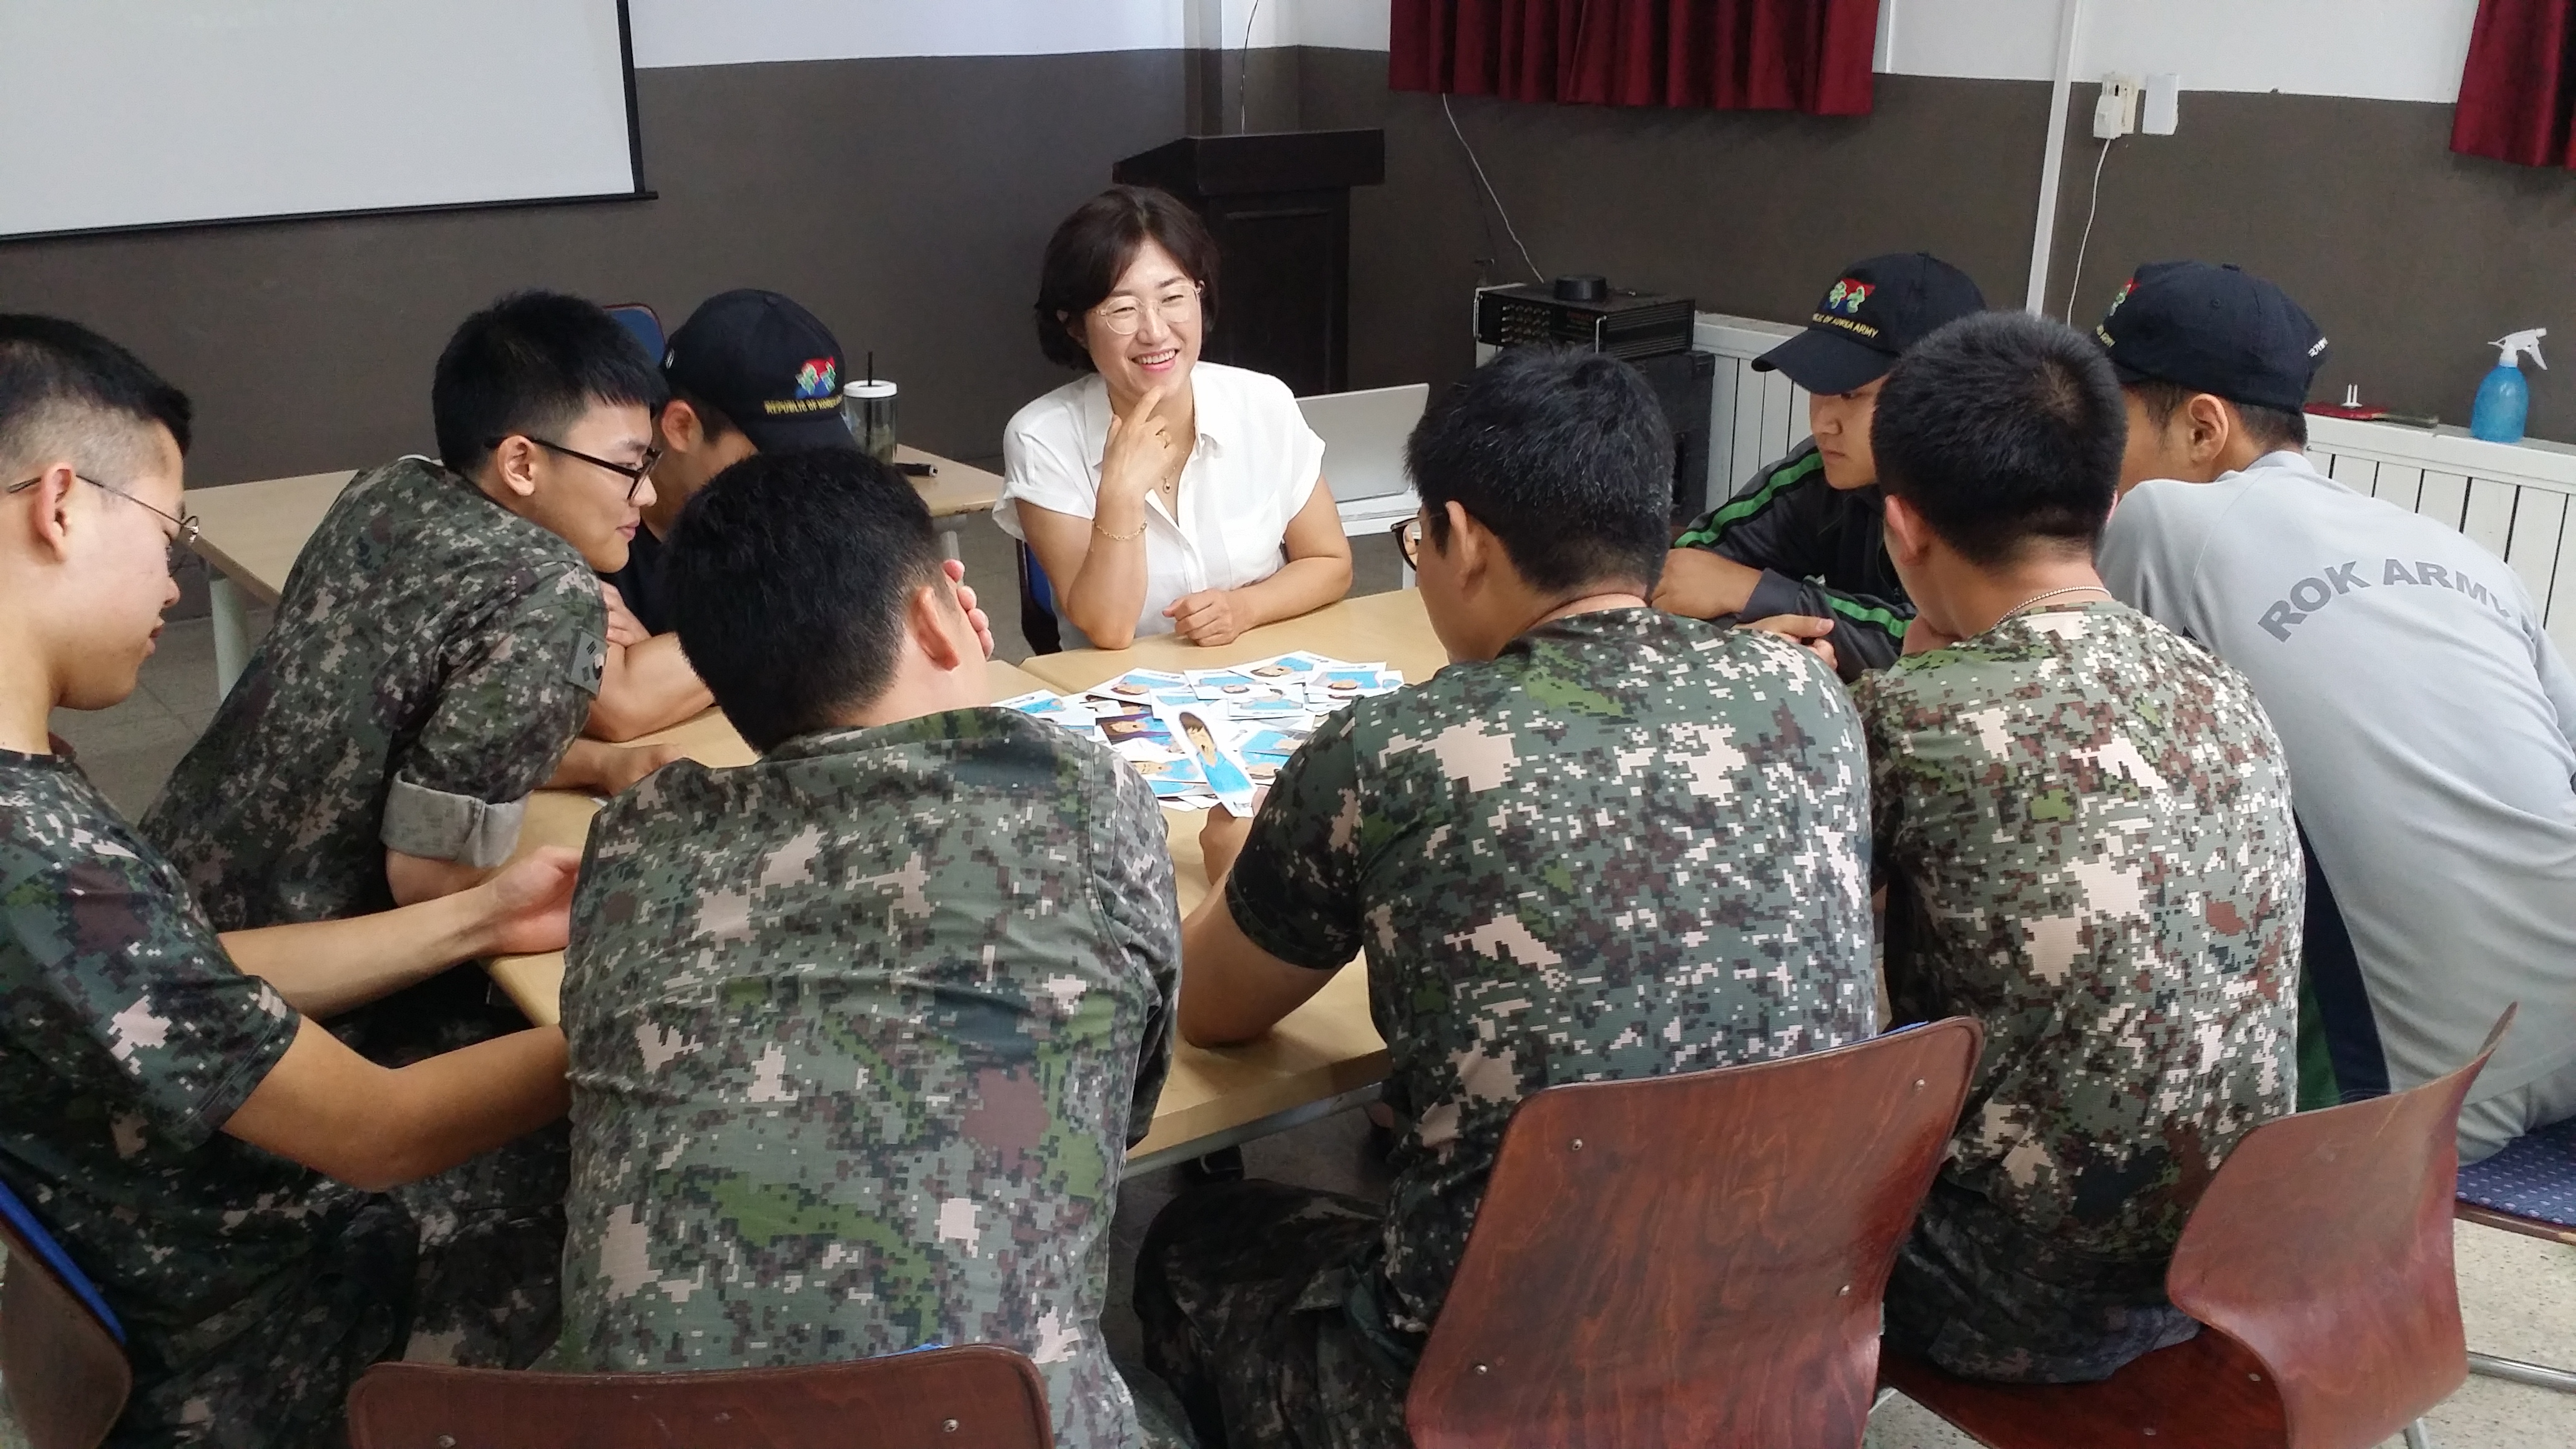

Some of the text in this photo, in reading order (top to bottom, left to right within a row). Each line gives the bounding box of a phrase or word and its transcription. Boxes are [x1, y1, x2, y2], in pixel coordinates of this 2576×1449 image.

[1832, 317, 1855, 330] KOREA
[1853, 322, 1879, 338] ARMY
[764, 399, 808, 415] REPUBLIC
[806, 398, 817, 411] OF
[2257, 560, 2372, 643] ROK
